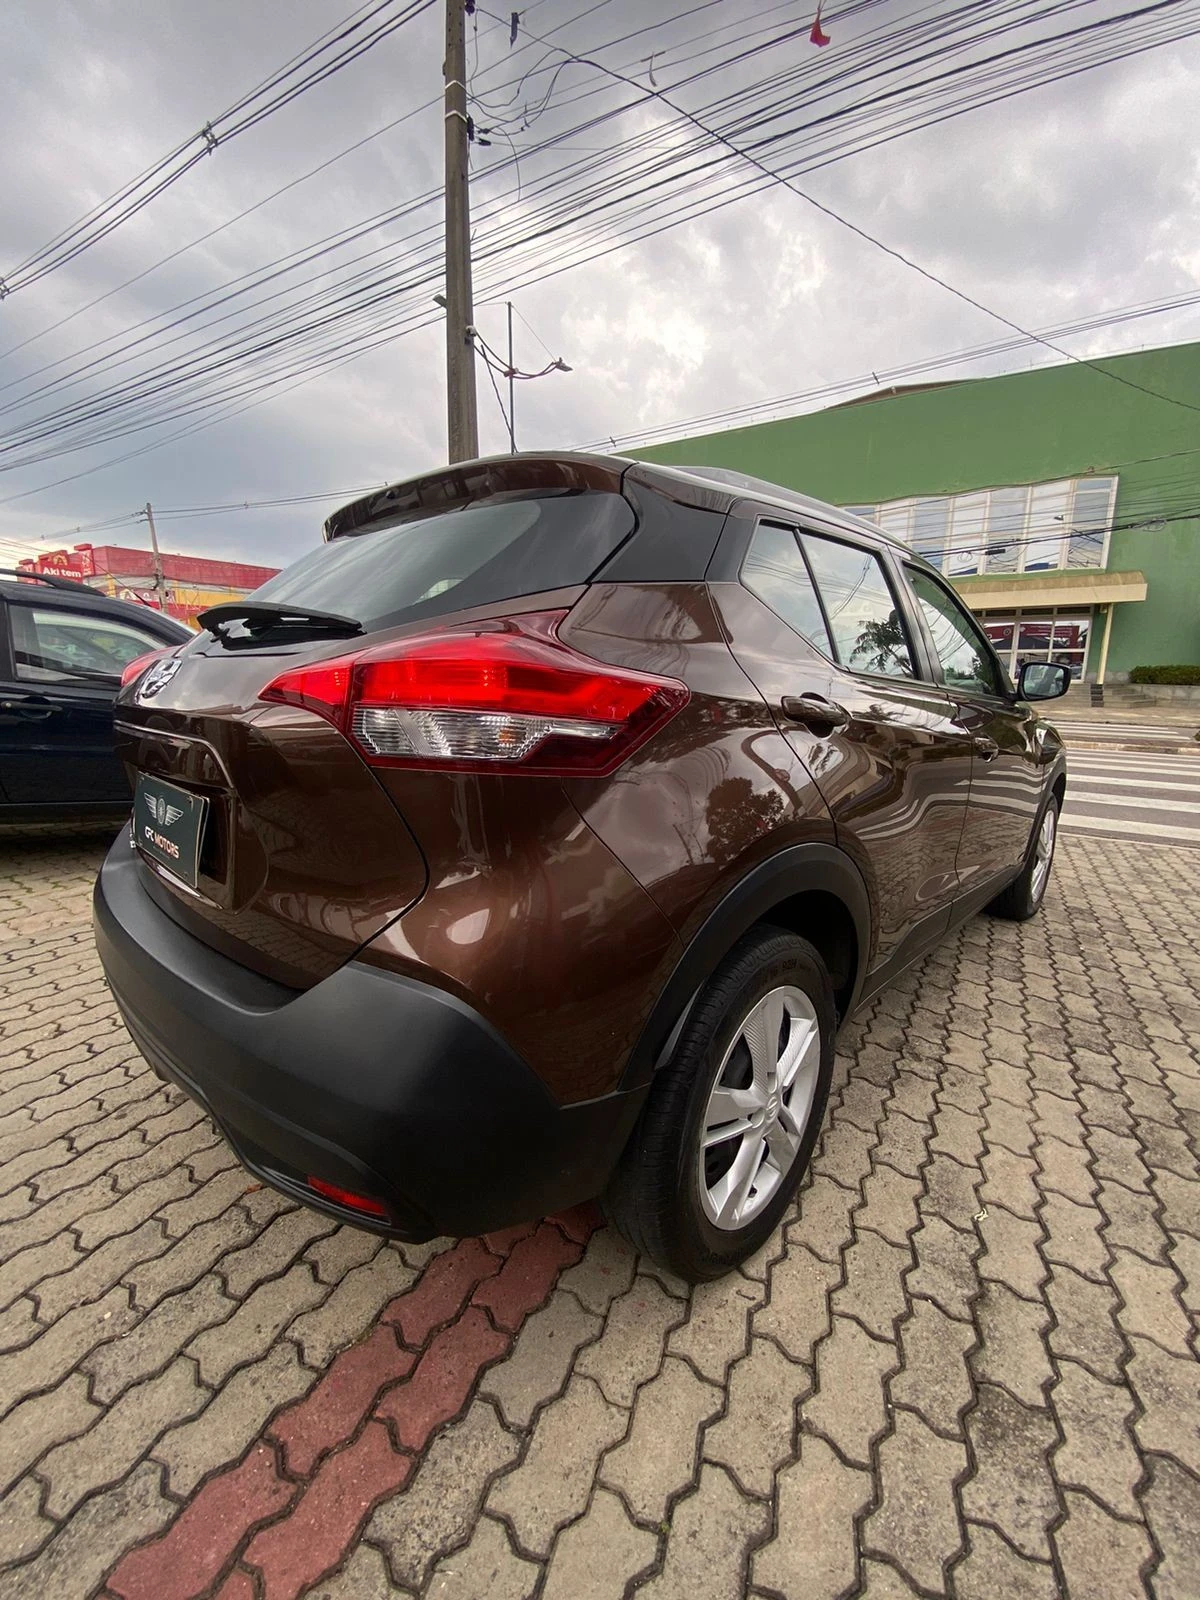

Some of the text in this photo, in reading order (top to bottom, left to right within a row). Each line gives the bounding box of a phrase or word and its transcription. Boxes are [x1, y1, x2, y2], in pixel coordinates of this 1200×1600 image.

[43, 567, 82, 578] Aki tem
[154, 832, 179, 858] MOTORS
